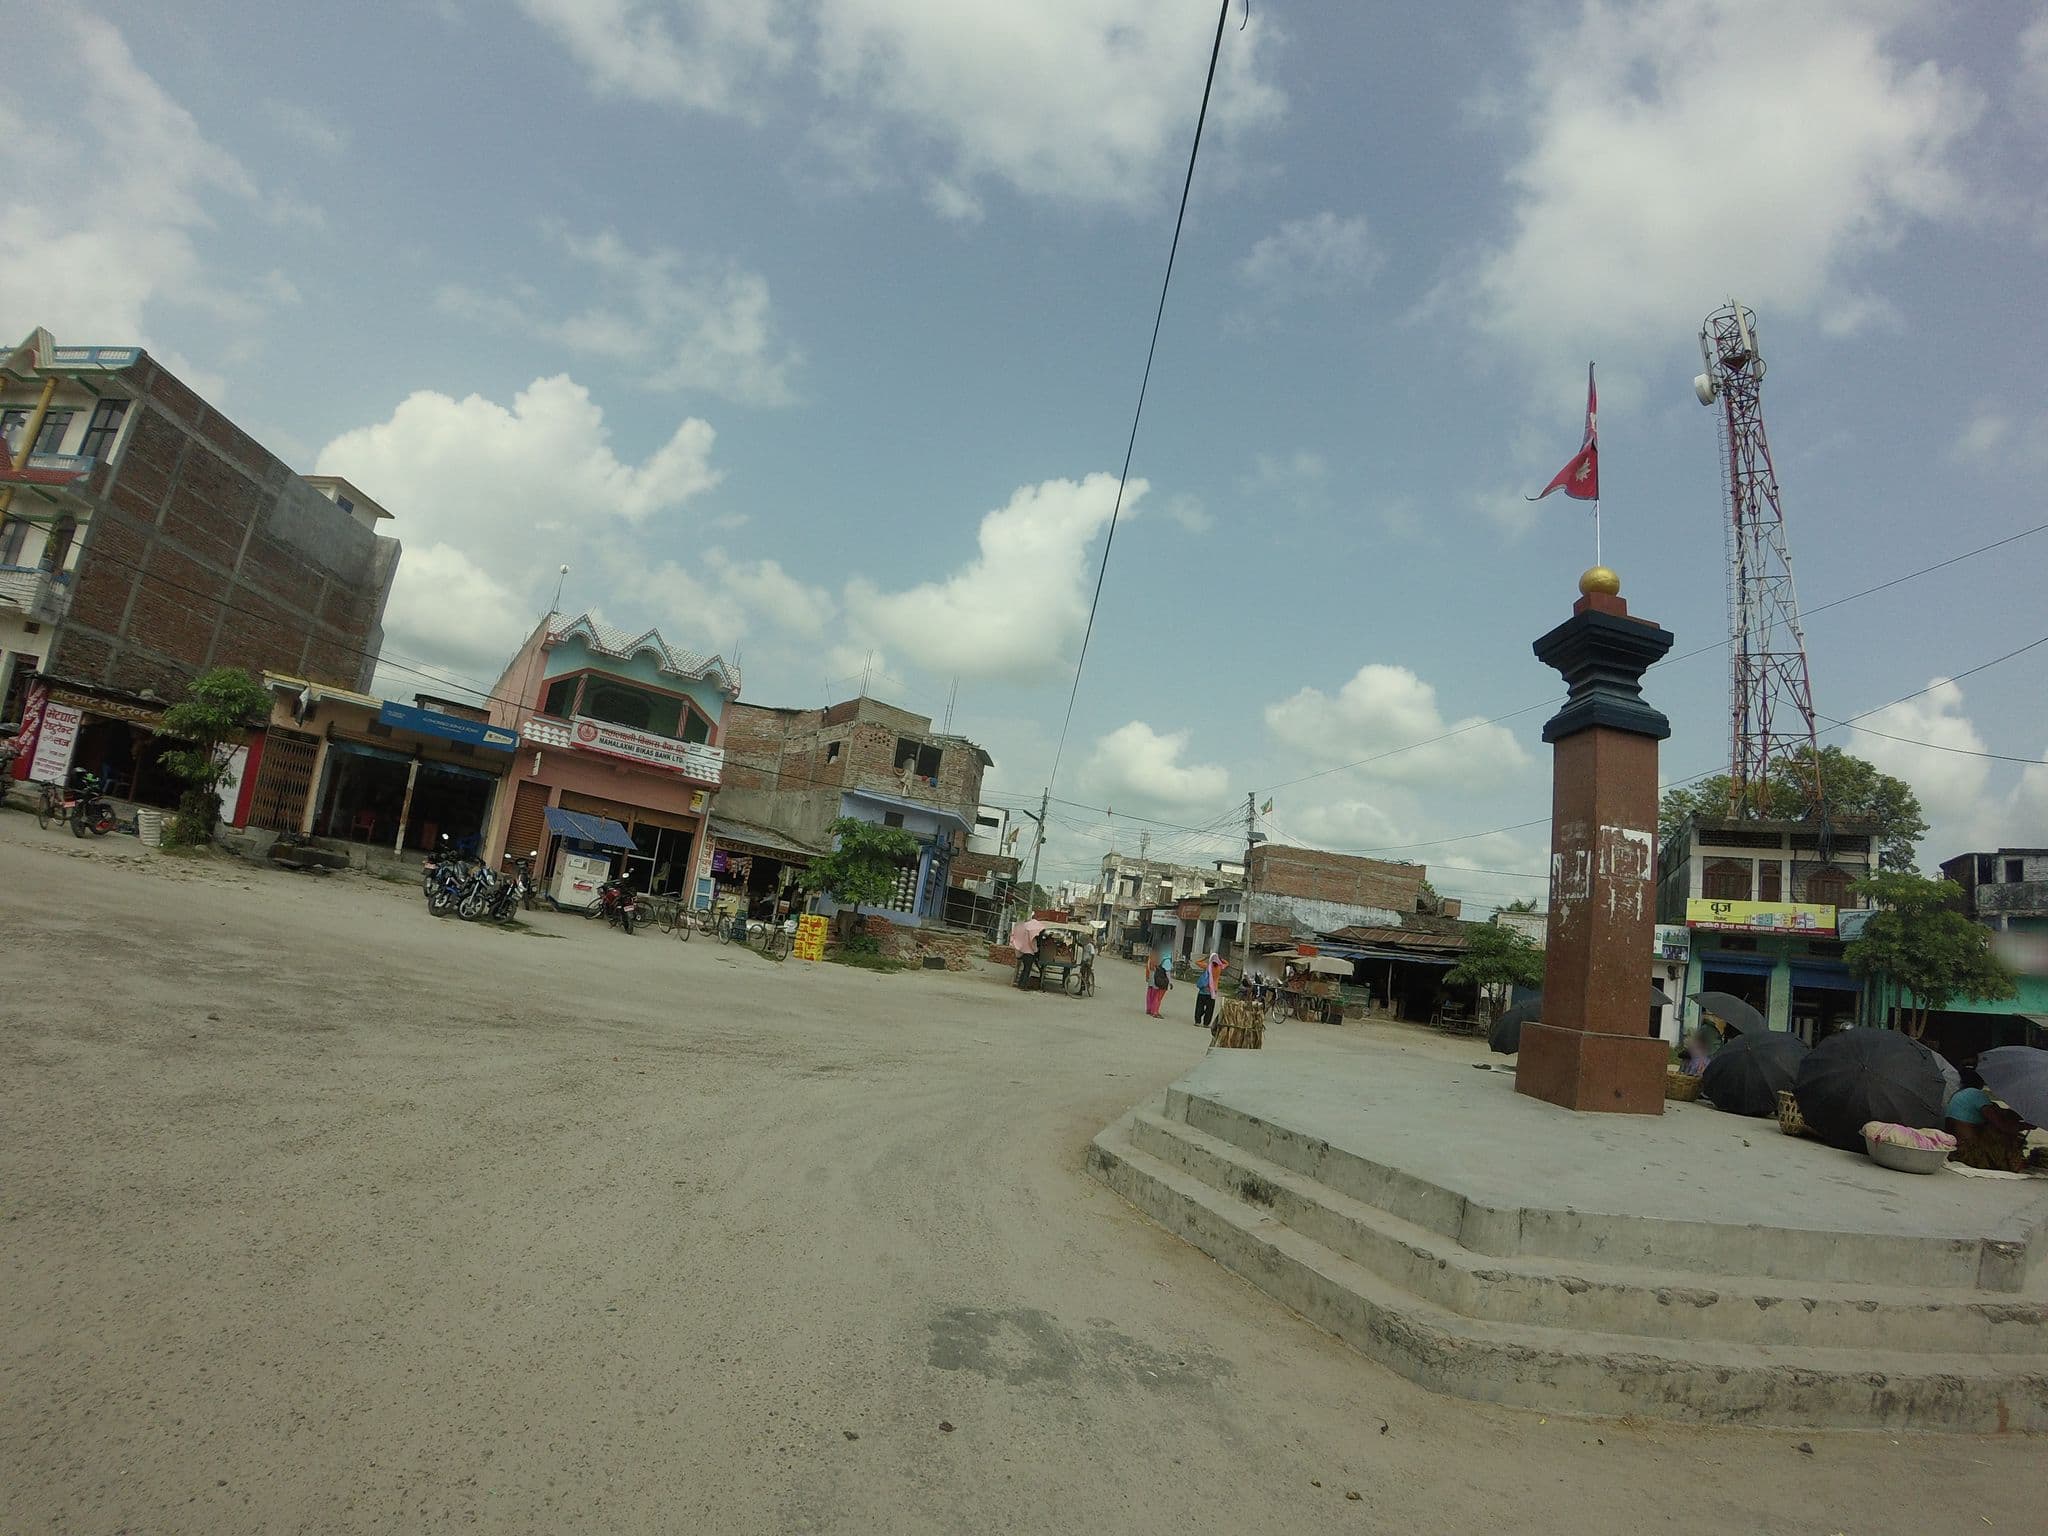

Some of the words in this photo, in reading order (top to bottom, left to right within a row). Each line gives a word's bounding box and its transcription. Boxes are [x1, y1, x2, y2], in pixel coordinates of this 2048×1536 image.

[599, 737, 635, 752] MAHALAXMI
[636, 747, 654, 756] BIKAS
[654, 751, 672, 761] BANK
[1710, 902, 1731, 914] वृज
